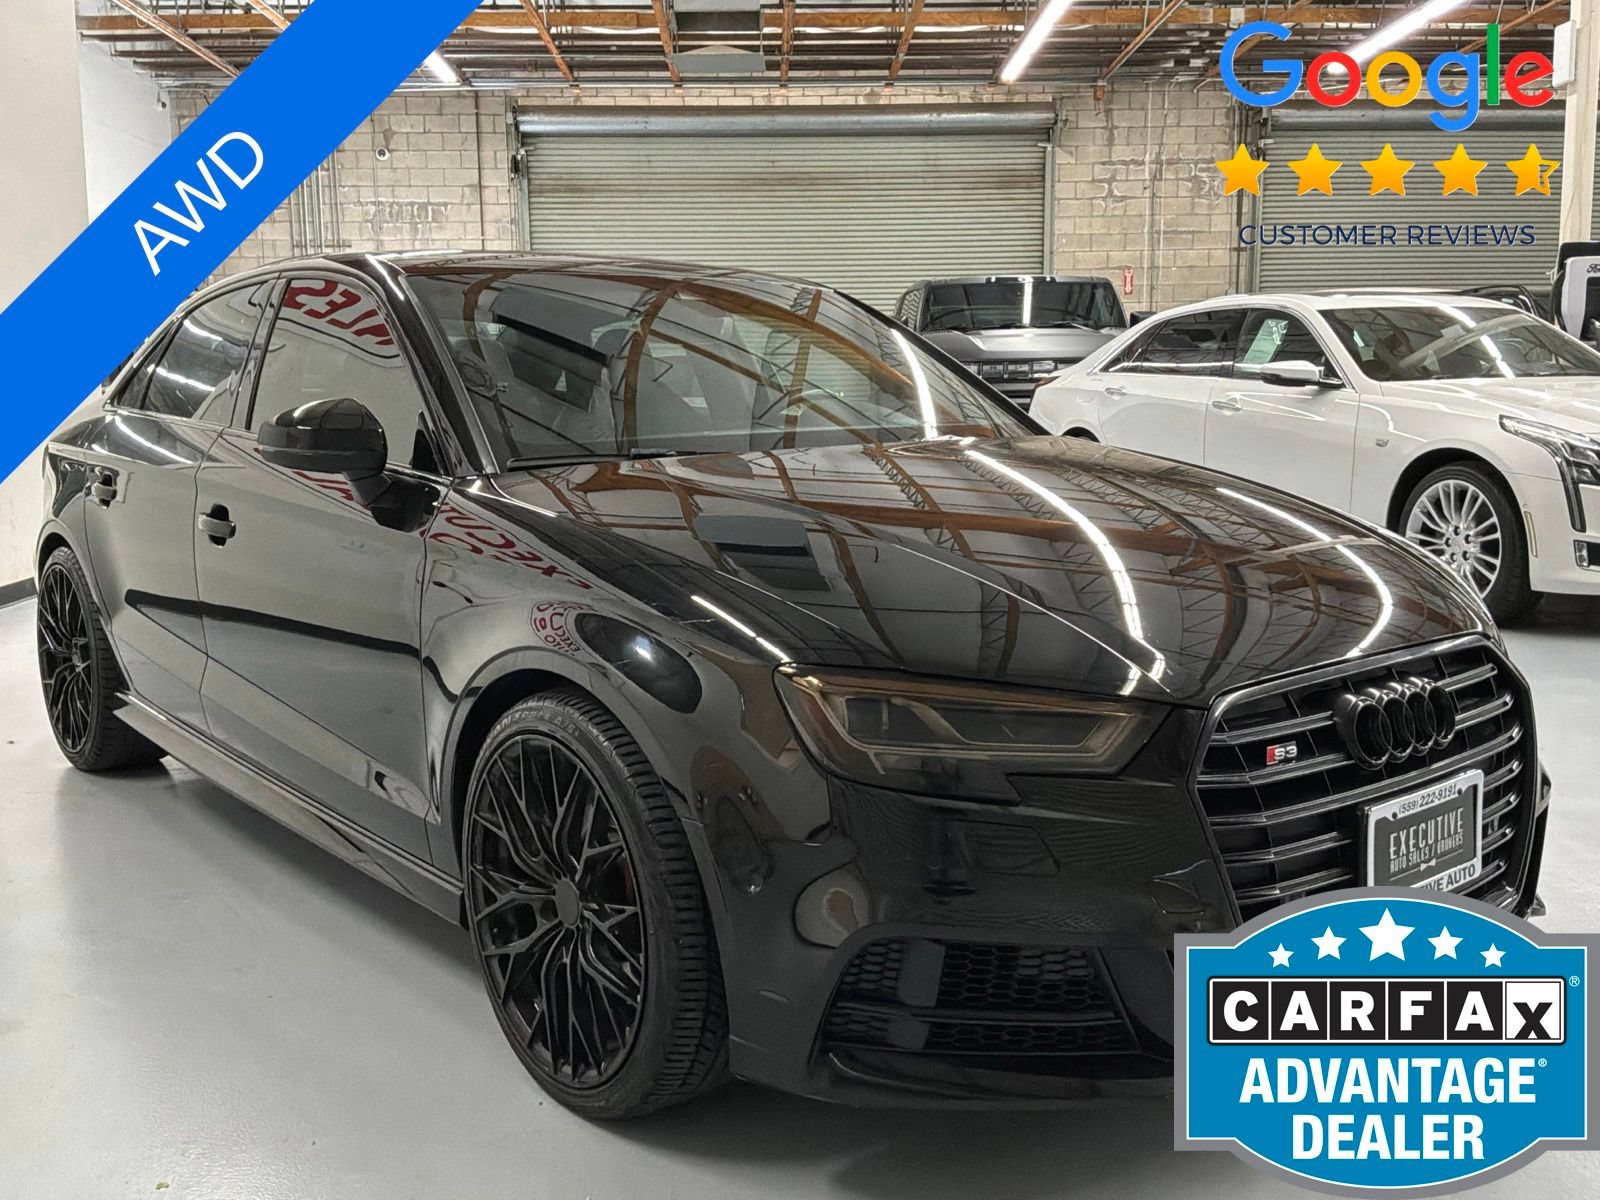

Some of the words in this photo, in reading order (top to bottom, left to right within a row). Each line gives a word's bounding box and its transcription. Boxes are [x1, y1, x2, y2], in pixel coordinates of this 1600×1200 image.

[1273, 744, 1298, 760] S3
[1389, 807, 1464, 859] EXECUTIVE
[1390, 855, 1407, 873] AUTO
[1408, 846, 1429, 866] SALES
[1445, 863, 1476, 888] AUTO
